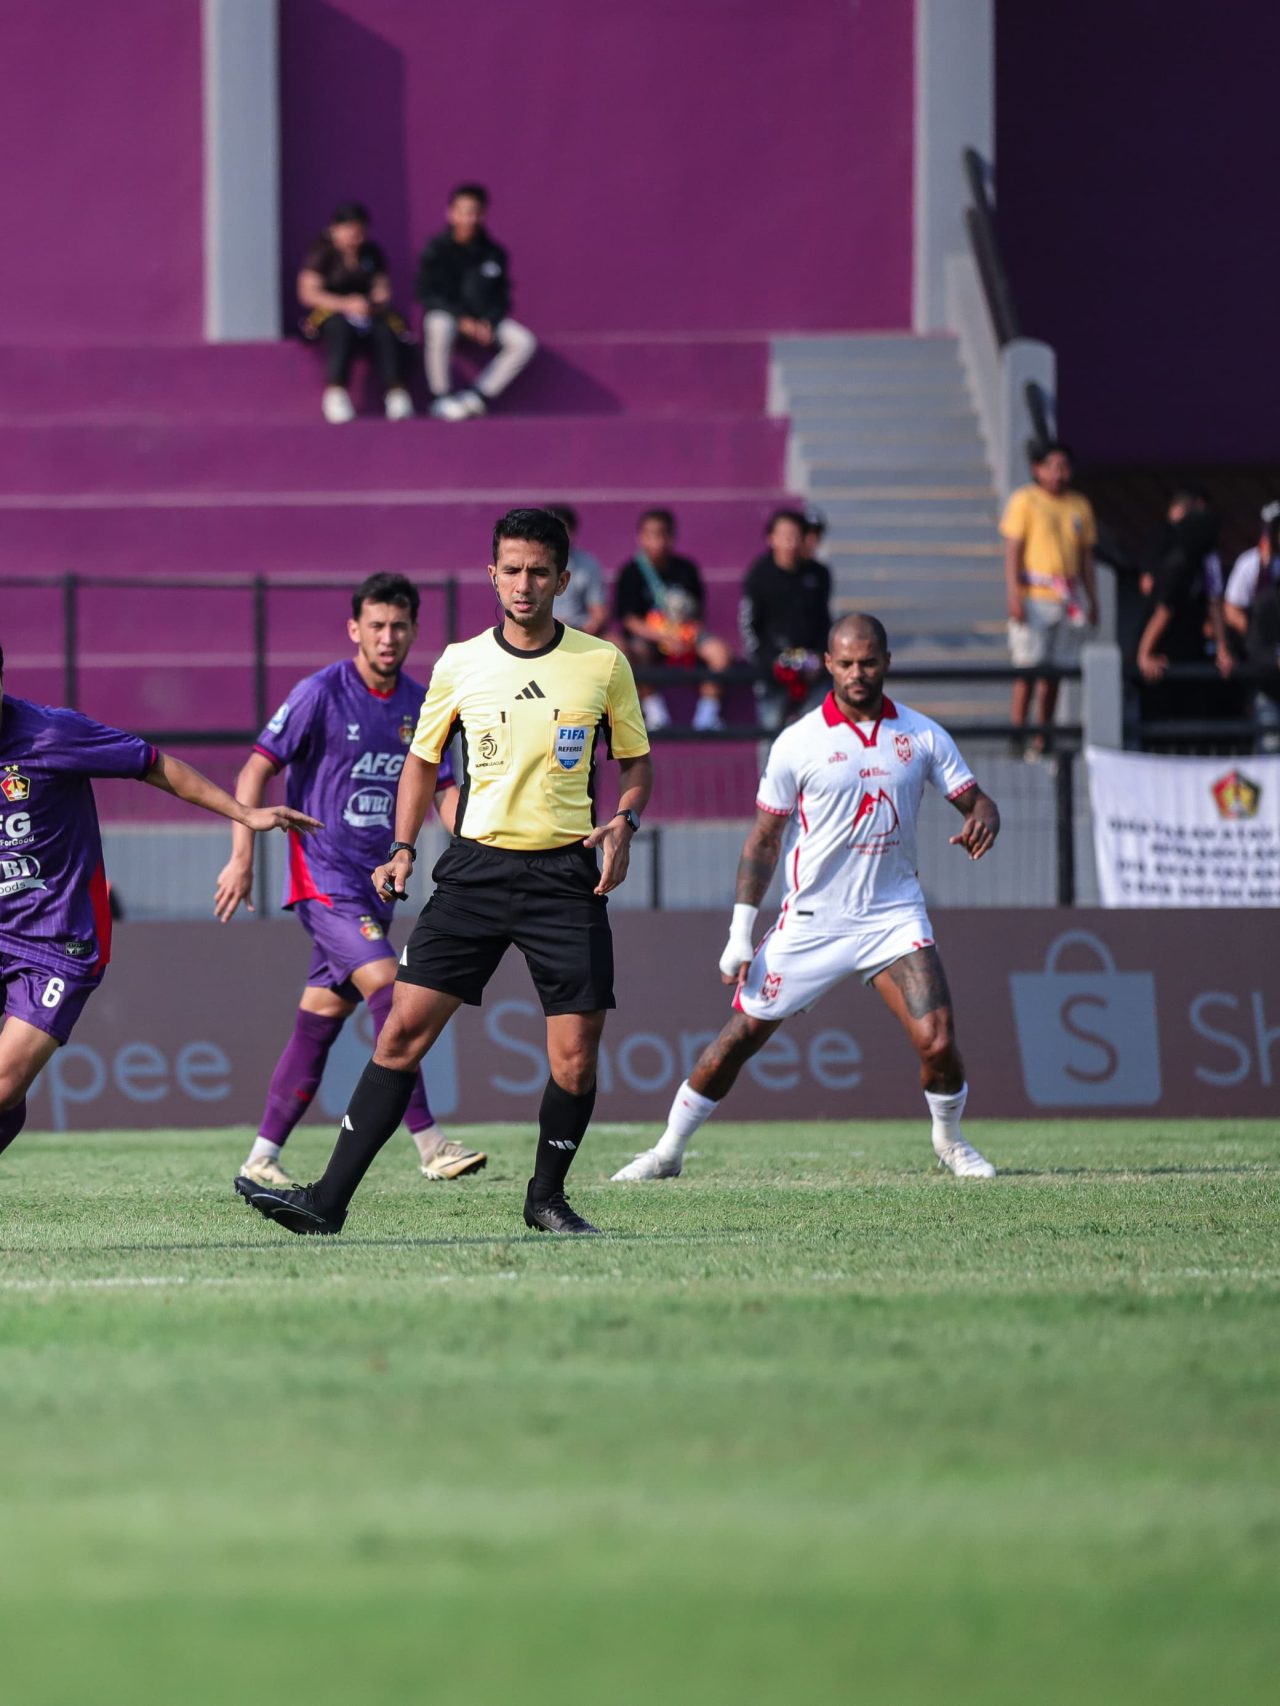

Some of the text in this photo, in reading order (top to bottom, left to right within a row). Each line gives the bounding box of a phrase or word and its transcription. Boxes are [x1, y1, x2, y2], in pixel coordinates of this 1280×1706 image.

[560, 729, 585, 740] FIFA
[352, 752, 405, 776] AFG
[358, 795, 389, 813] WBI
[41, 977, 65, 1009] 6
